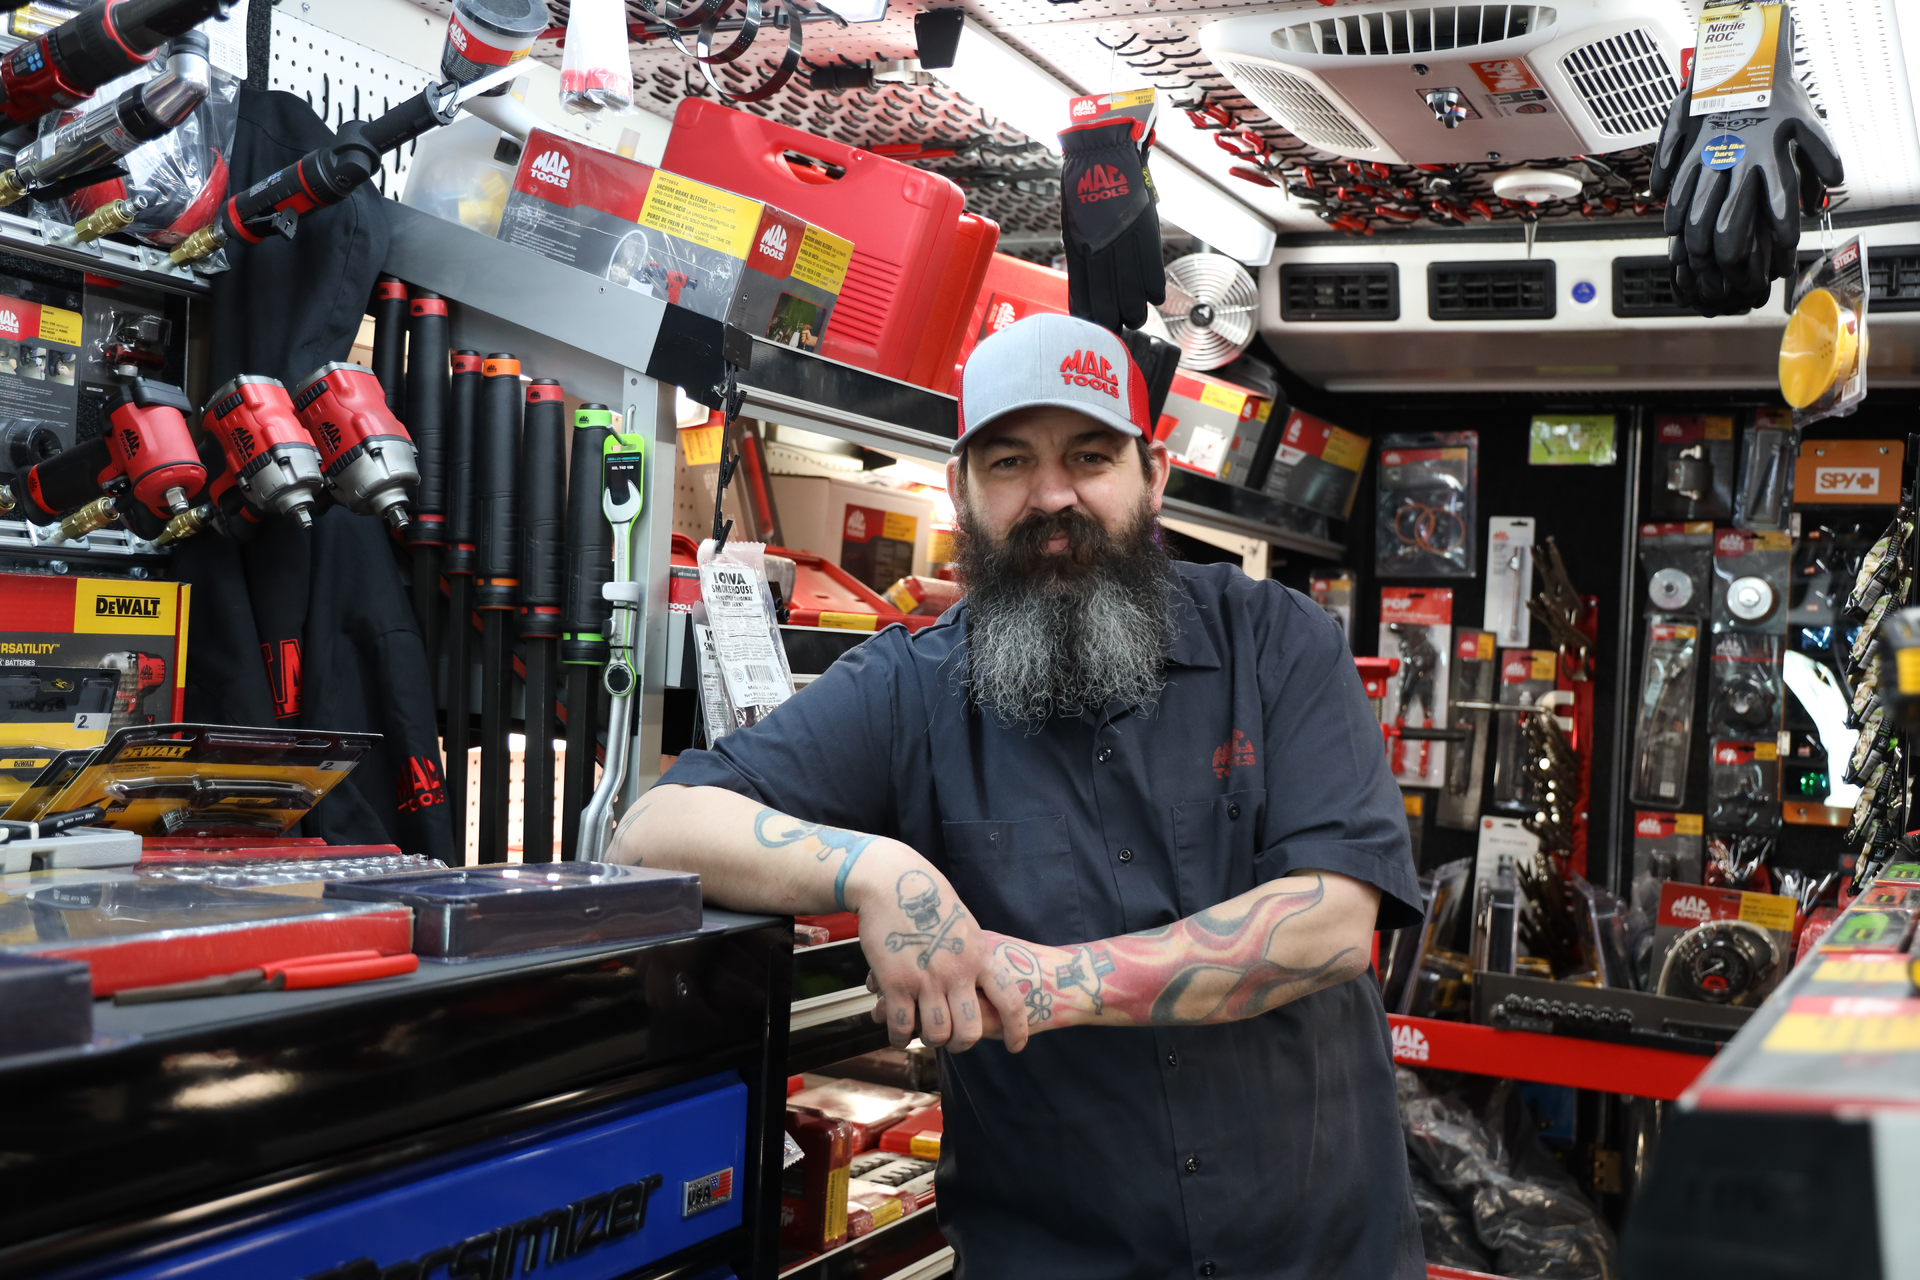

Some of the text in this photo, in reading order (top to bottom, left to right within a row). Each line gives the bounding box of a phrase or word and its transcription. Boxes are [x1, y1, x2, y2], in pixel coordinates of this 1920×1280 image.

[1707, 21, 1745, 33] Nitrile
[1705, 31, 1735, 43] ROC
[1073, 100, 1096, 113] MAC
[1073, 109, 1096, 117] TOOLS
[1704, 144, 1727, 152] Feels
[531, 151, 571, 180] MAC
[530, 169, 568, 189] TOOLS
[1077, 164, 1128, 195] MAC
[651, 197, 666, 206] PURGA
[656, 183, 675, 194] VACUUM
[675, 189, 689, 198] BRAKE
[689, 194, 708, 204] BLEEDER
[1078, 185, 1130, 204] TOOLS
[646, 212, 661, 221] PURGE
[667, 219, 680, 227] FREIN
[761, 224, 787, 252] MAC
[759, 243, 784, 261] TOOLS
[1833, 247, 1858, 271] STECK
[0, 324, 19, 333] OOLS
[1060, 349, 1119, 386] MAC
[1060, 373, 1120, 399] TOOLS
[122, 429, 140, 457] MAC
[234, 427, 255, 459] MAC
[320, 421, 342, 452] MAC
[713, 571, 746, 585] IOWA
[711, 585, 753, 595] SMOKEHOUSE
[1382, 598, 1412, 609] POP
[5, 659, 36, 667] BATTERIES
[140, 665, 153, 675] MAC
[320, 761, 334, 771] 2
[1671, 896, 1710, 913] MAC
[1393, 1046, 1429, 1062] OOLS
